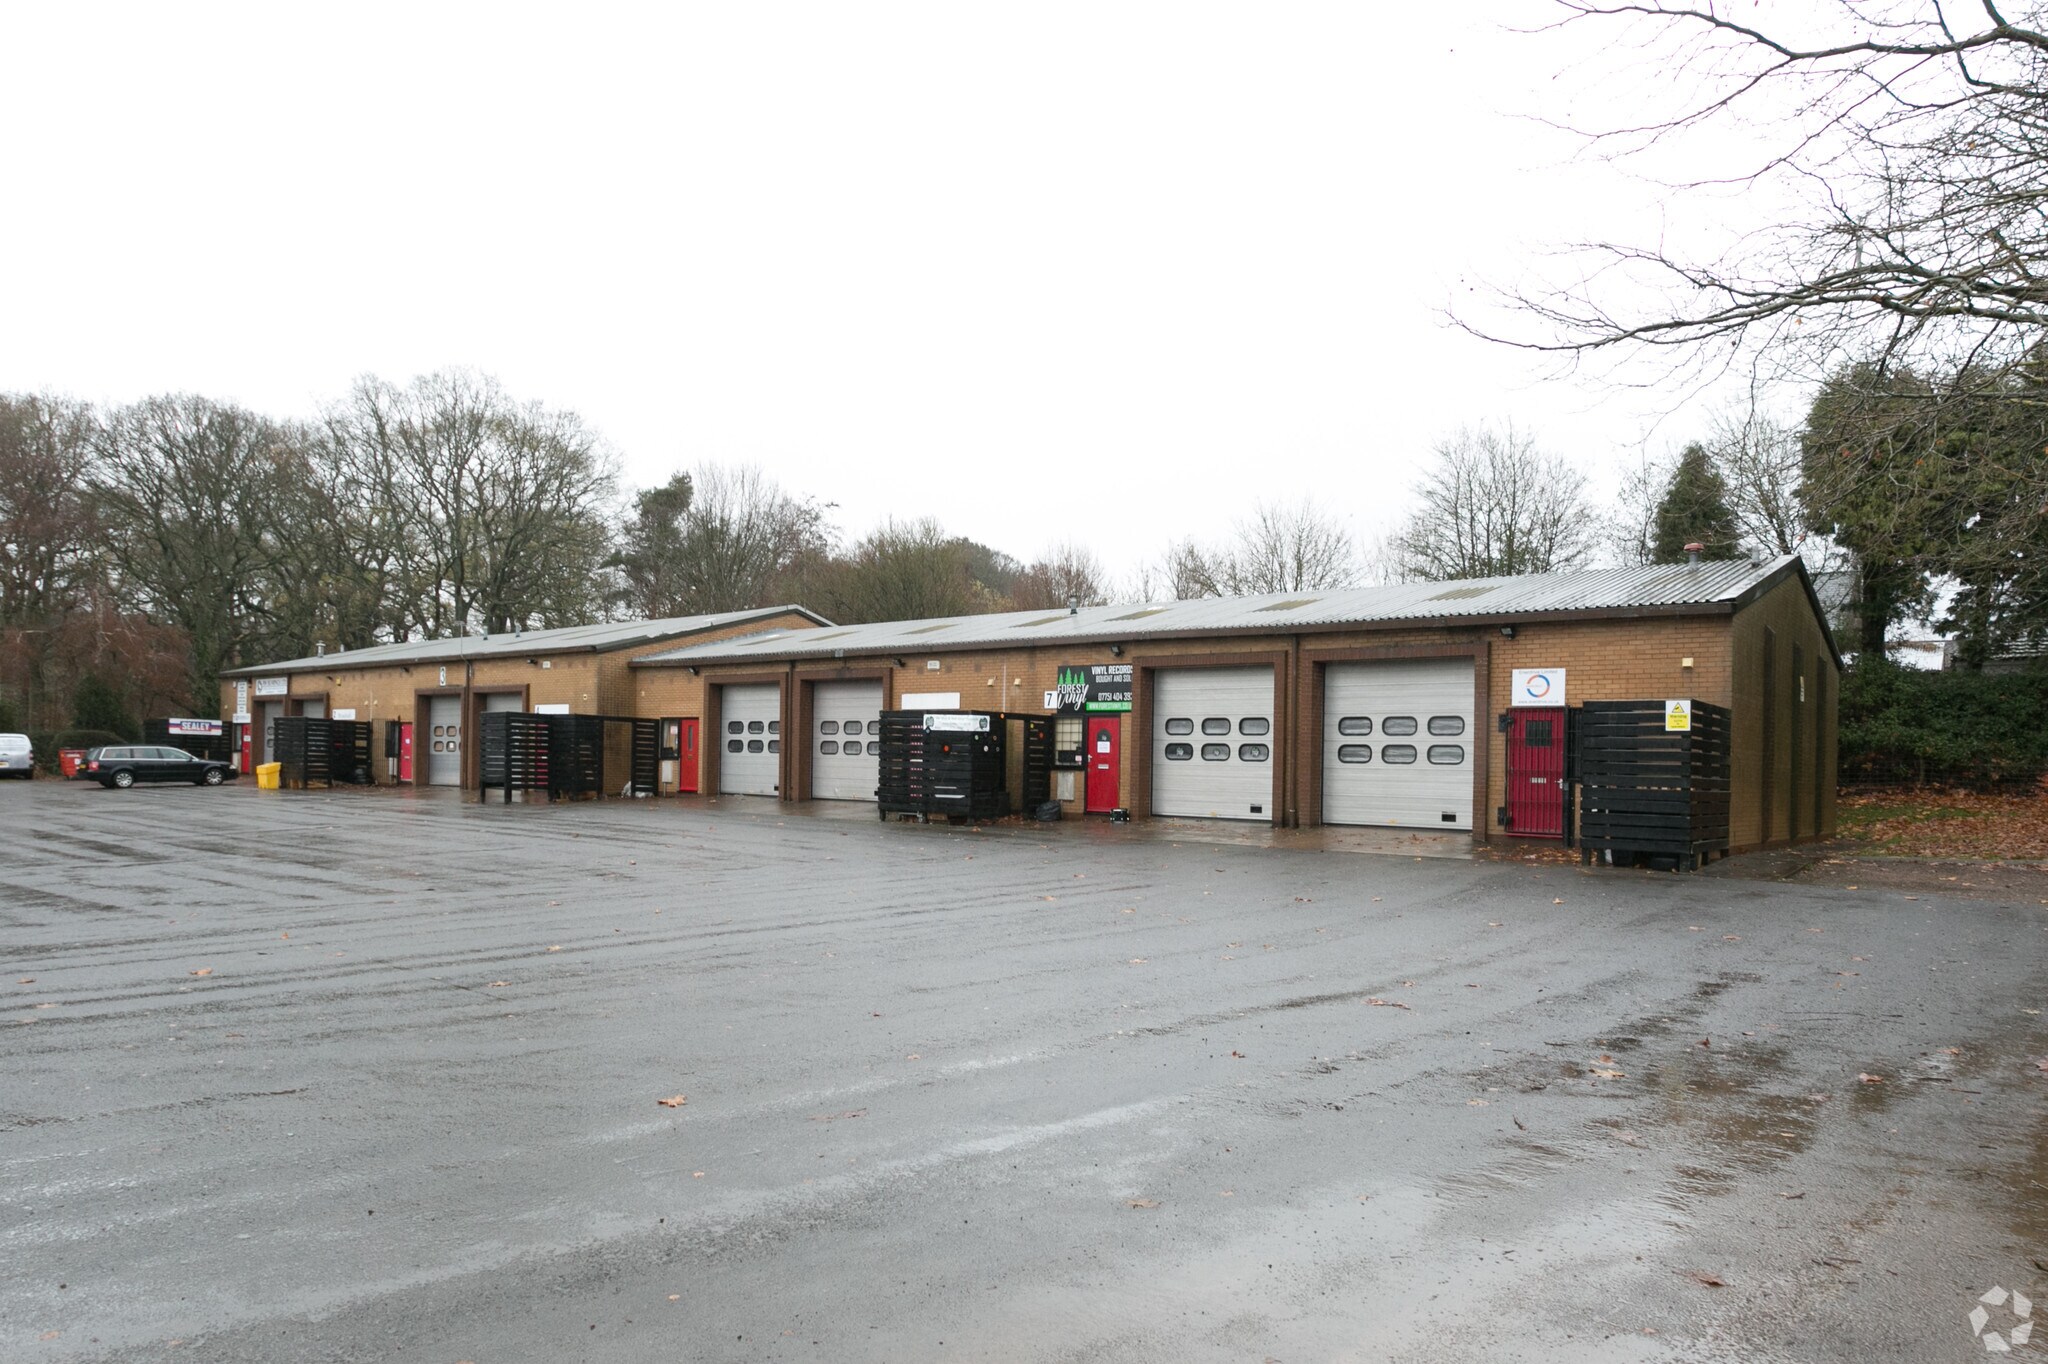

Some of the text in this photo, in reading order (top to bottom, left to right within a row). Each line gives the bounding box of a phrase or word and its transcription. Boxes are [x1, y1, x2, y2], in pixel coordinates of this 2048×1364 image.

[1091, 665, 1107, 675] VINYL
[1096, 675, 1112, 683] BOUGHT
[1113, 674, 1122, 683] AND
[1057, 684, 1085, 694] FOREST
[1047, 693, 1053, 706] 7
[1057, 684, 1089, 711] Vinyl
[1113, 692, 1122, 701] 404
[181, 721, 210, 731] SEALEY
